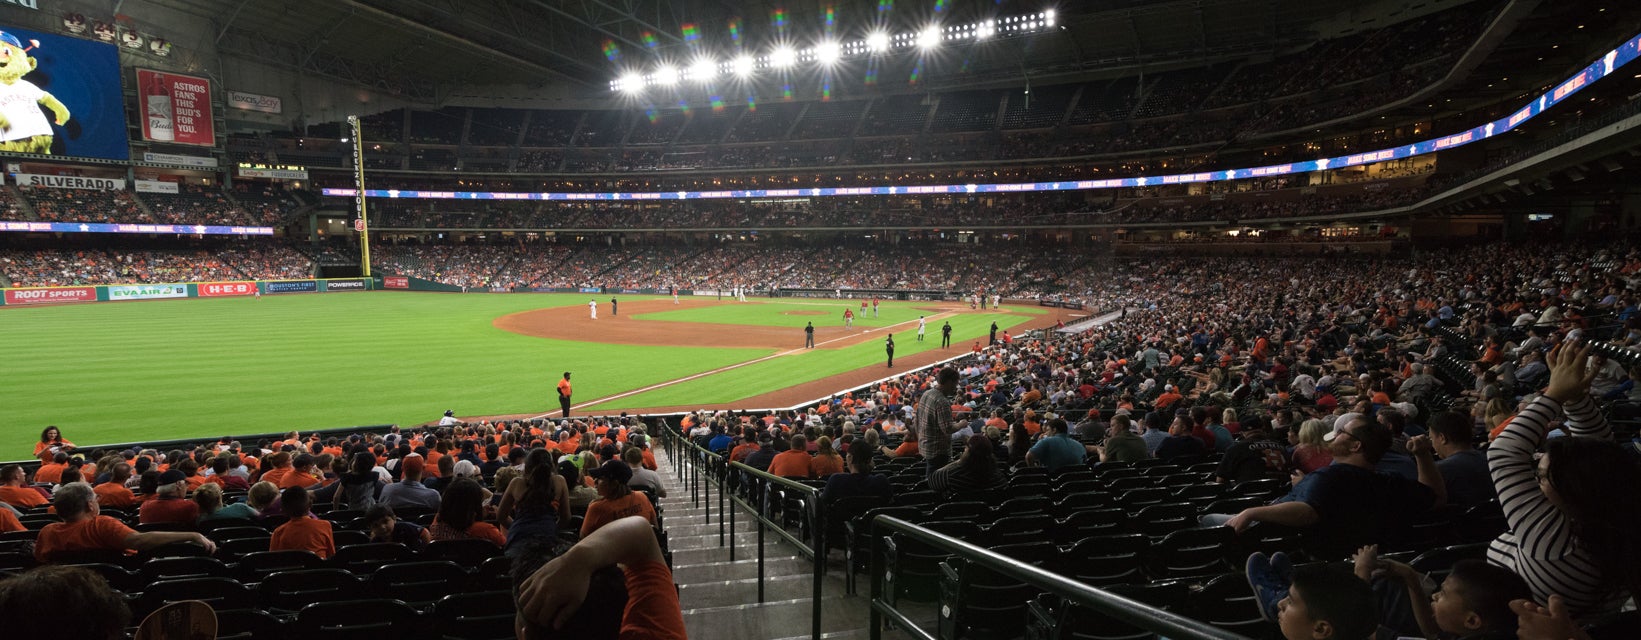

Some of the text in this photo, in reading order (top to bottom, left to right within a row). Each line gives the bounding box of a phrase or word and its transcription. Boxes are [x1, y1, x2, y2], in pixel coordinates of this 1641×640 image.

[129, 29, 138, 41] 5
[174, 81, 206, 94] ASTROS
[174, 90, 198, 102] FANS,
[230, 91, 257, 104] Texas
[175, 99, 195, 109] THIS
[176, 107, 201, 118] BUD'S
[177, 115, 194, 125] FOR
[177, 124, 198, 134] YOU.
[31, 175, 114, 190] SILVERADO
[15, 289, 48, 299] ROOT
